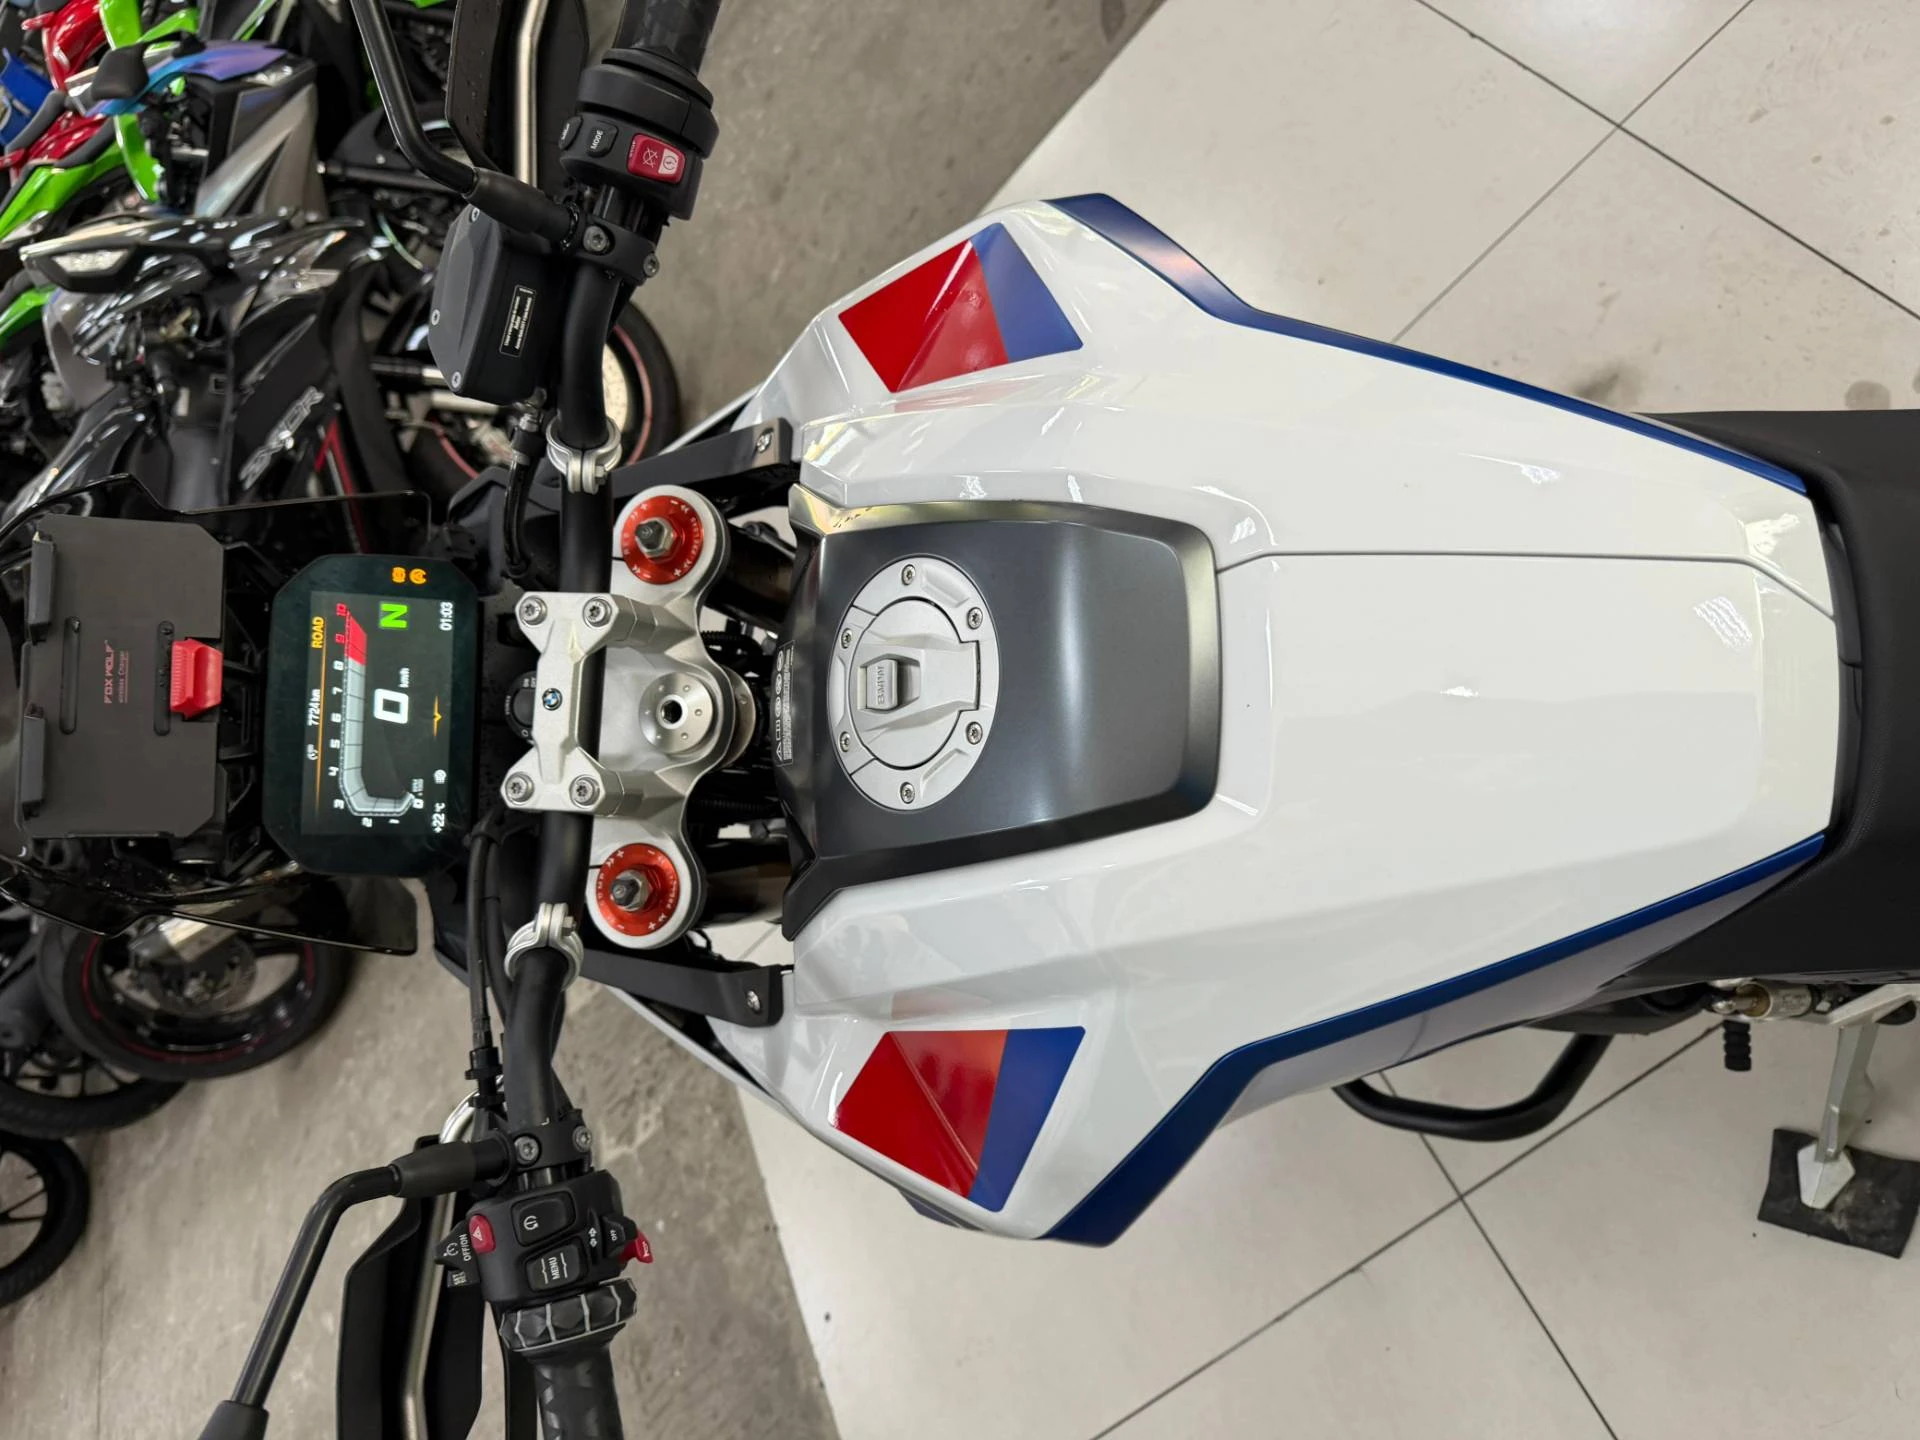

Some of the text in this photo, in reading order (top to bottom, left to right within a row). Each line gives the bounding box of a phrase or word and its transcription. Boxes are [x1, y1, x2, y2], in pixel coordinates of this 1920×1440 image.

[590, 130, 604, 150] MODE
[336, 603, 347, 617] 10
[379, 602, 409, 629] N
[439, 602, 453, 631] 01:03
[310, 616, 325, 649] ROAD
[333, 660, 345, 671] 8
[104, 679, 113, 703] FOX
[332, 687, 343, 696] 7
[877, 666, 885, 705] BMW
[307, 689, 320, 726] 7724 km
[373, 688, 409, 725] 0
[330, 712, 342, 723] 6
[329, 738, 341, 749] 5
[328, 766, 339, 776] 4
[333, 799, 345, 810] 3
[412, 798, 424, 809] 0
[361, 817, 373, 828] 2
[431, 813, 445, 833] +22
[609, 1229, 618, 1242] OFF
[460, 1233, 472, 1262] OFF/ON
[550, 1257, 560, 1280] MENU
